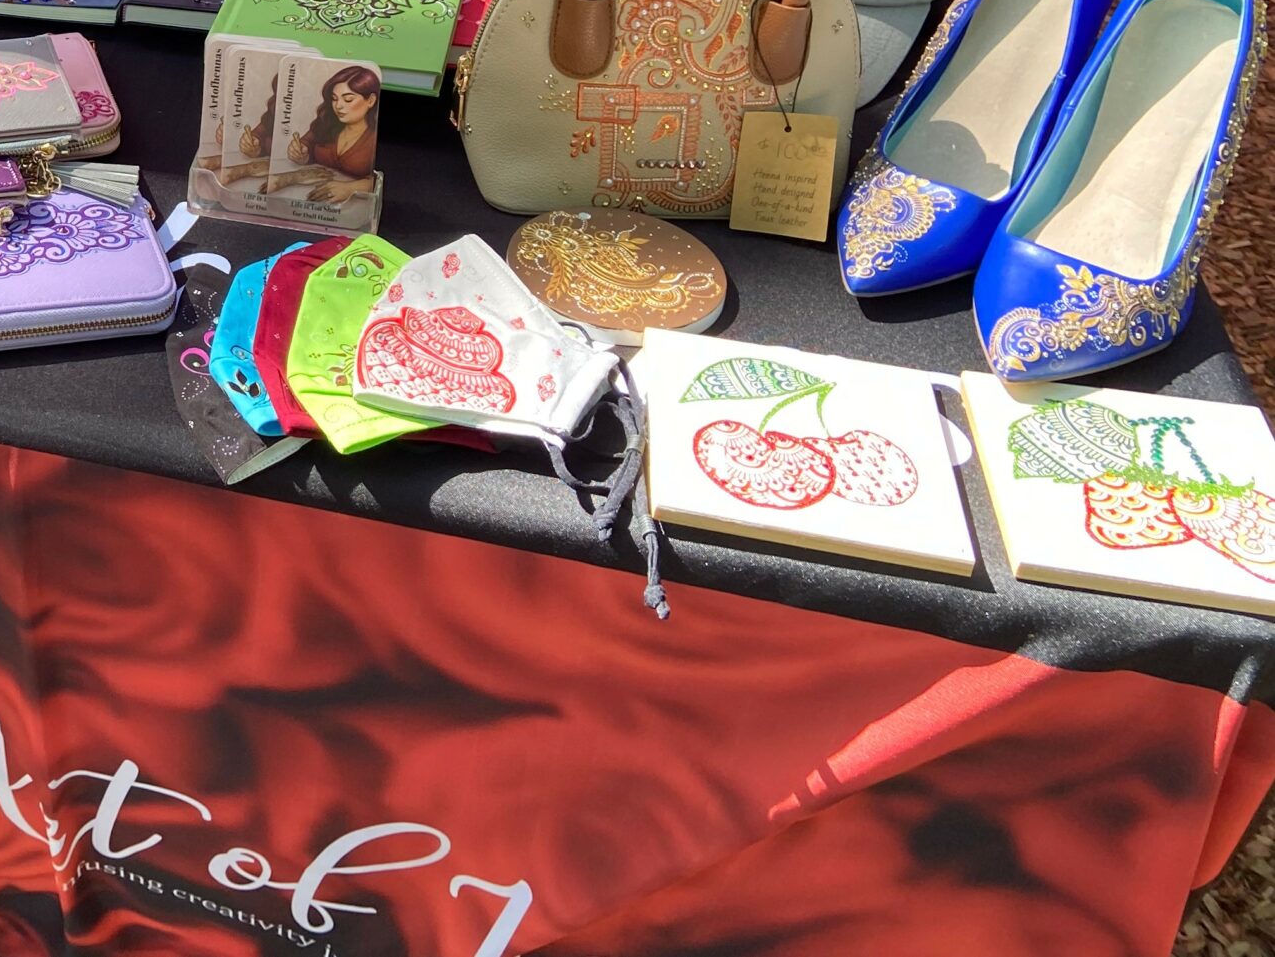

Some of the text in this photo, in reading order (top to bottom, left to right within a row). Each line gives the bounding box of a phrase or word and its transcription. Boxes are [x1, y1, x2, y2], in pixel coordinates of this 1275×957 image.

[281, 63, 296, 136] @Artofhennas
[753, 167, 819, 185] Henna inspired
[753, 182, 816, 201] Hand designed
[323, 205, 341, 214] Short
[755, 211, 808, 227] Faux leather
[209, 822, 451, 933] of
[172, 888, 316, 948] creativity
